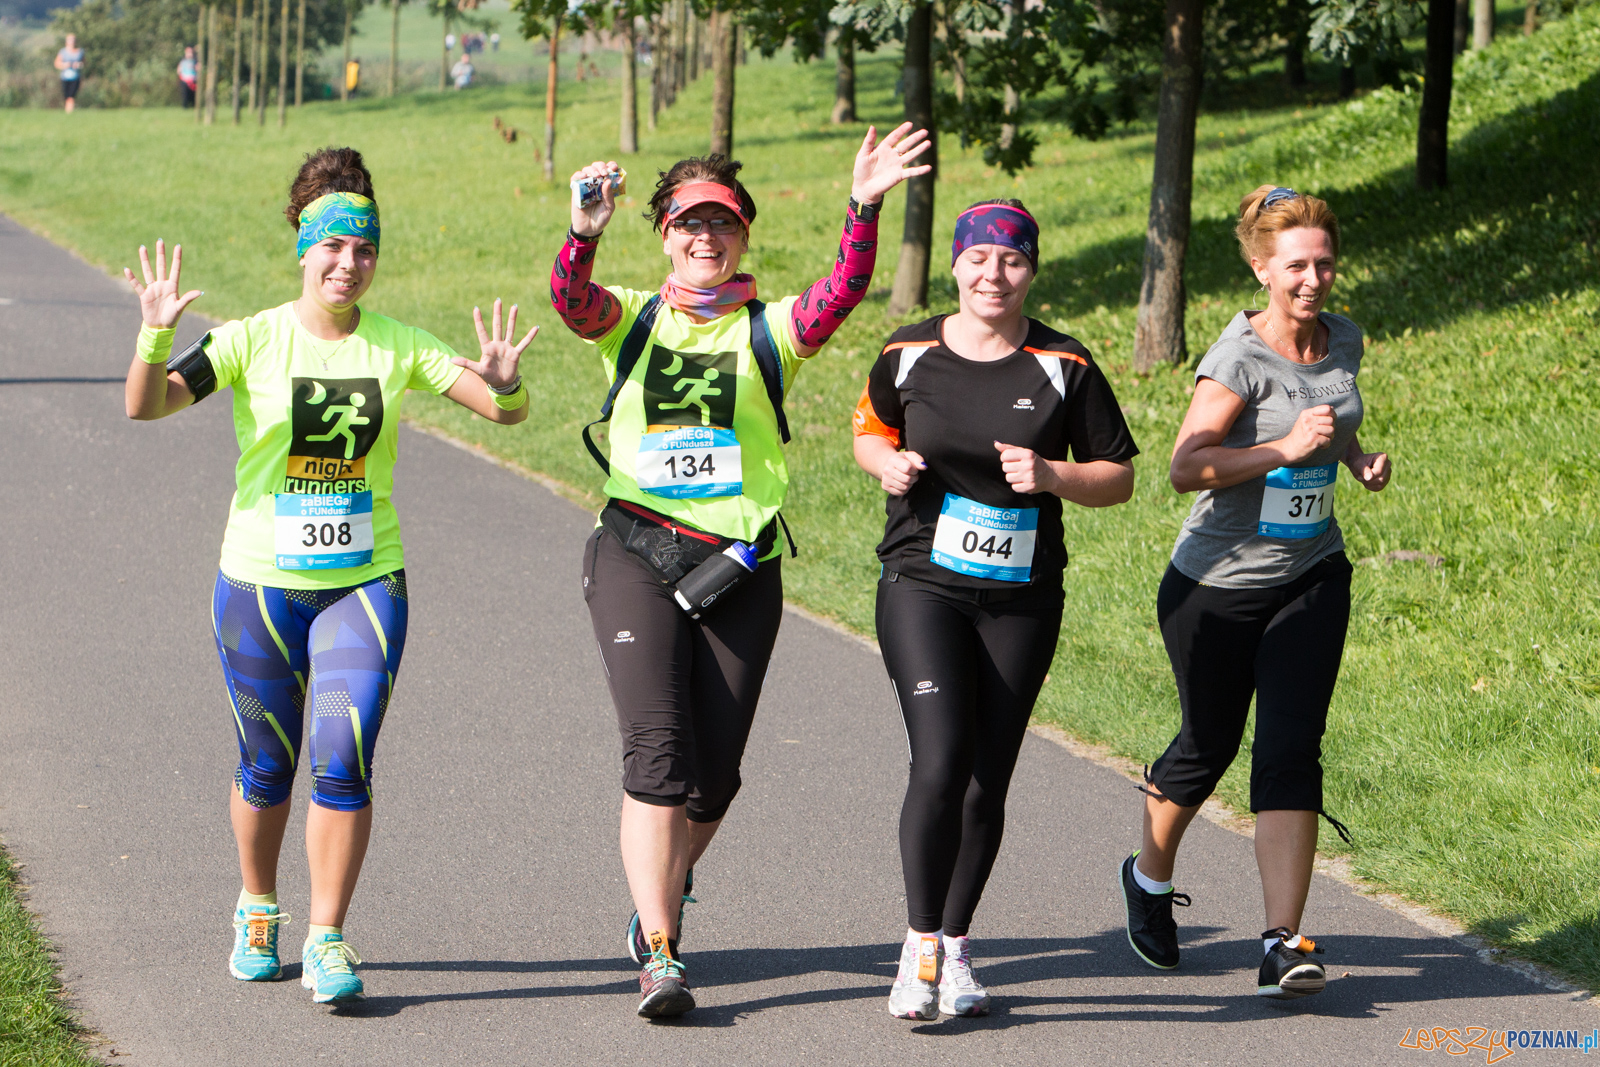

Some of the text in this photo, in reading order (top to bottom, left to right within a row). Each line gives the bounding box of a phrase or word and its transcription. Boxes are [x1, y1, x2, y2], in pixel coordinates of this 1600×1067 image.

[662, 429, 714, 441] zaBIEGaj
[670, 440, 714, 450] FUNdusze
[665, 453, 716, 479] 134
[285, 478, 366, 495] runners
[300, 495, 352, 507] zaBIEGaj
[1288, 492, 1324, 517] 371
[309, 507, 351, 516] FUNdusze
[968, 505, 1020, 523] zaBIEGaj
[967, 515, 1018, 530] o FUNdusze
[302, 522, 352, 547] 308
[962, 530, 1013, 560] 044
[254, 925, 265, 945] 308
